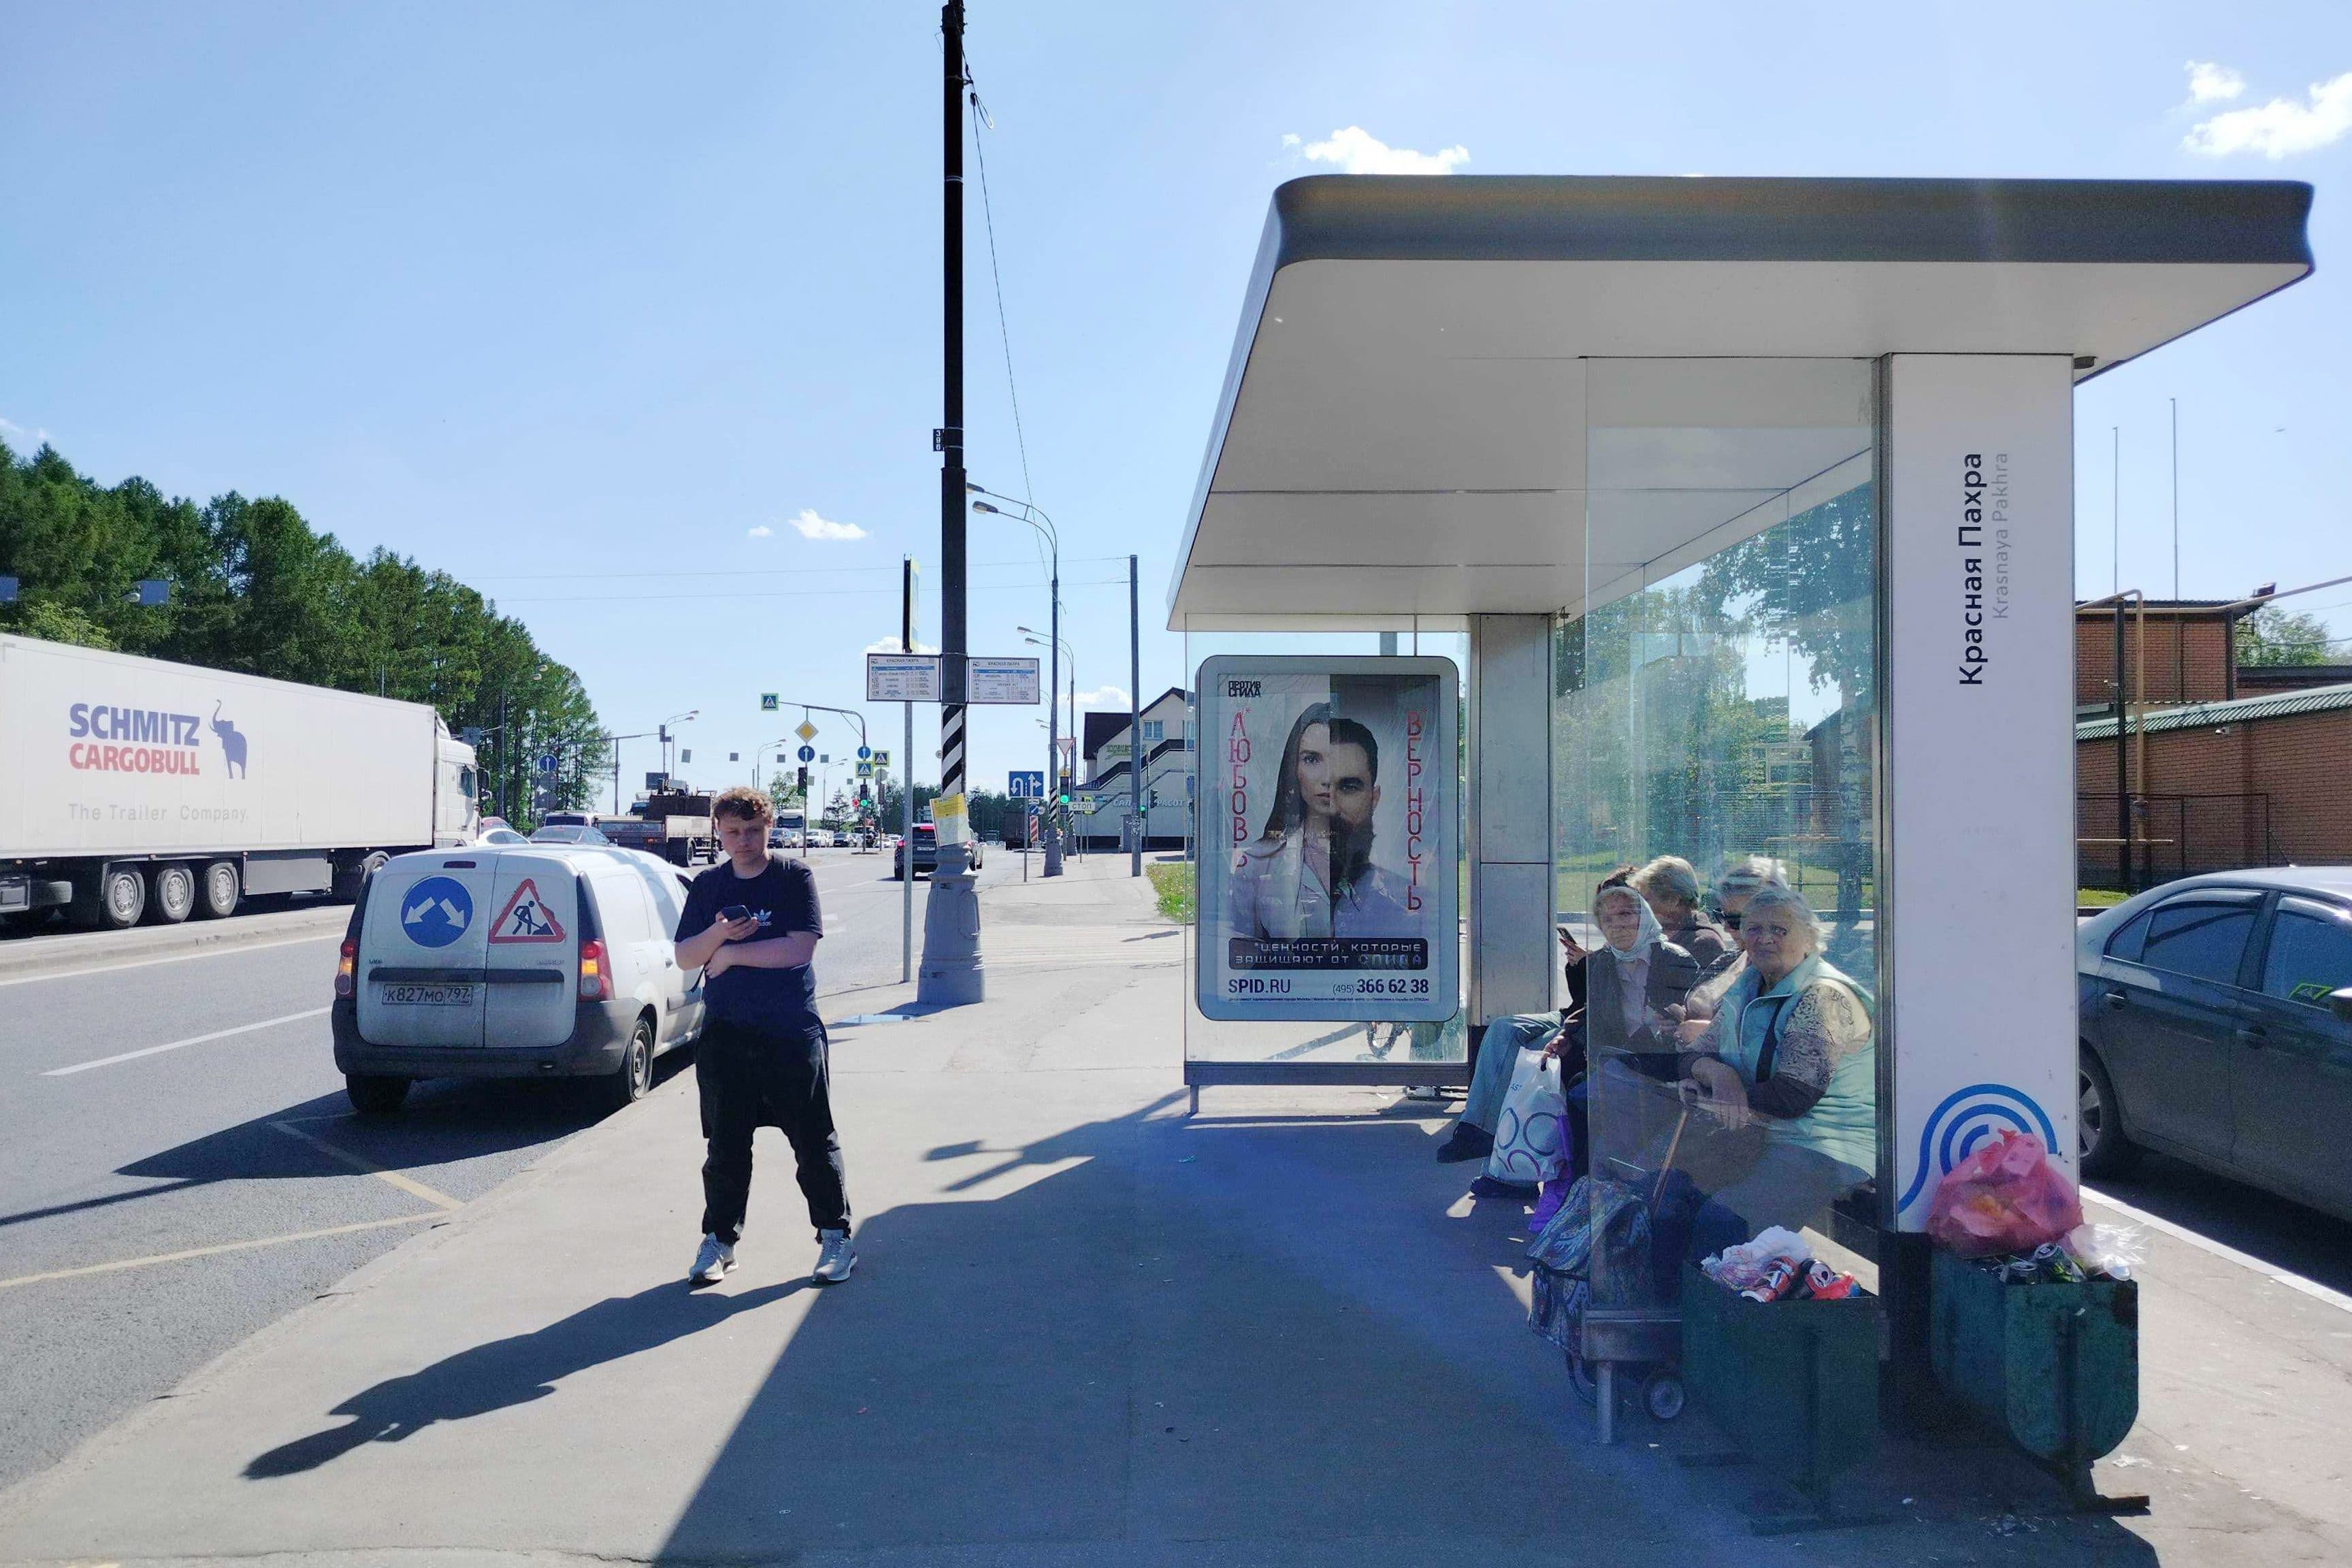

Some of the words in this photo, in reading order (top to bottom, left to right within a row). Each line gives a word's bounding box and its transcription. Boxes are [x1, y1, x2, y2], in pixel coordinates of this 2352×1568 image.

[1958, 453, 1987, 546] Пахра
[1991, 453, 2008, 521] Pakhra
[1992, 529, 2011, 619] Krasnaya
[1959, 558, 1988, 685] Красная
[69, 703, 200, 746] SCHMITZ
[69, 742, 200, 775] CARGOBULL
[68, 803, 101, 820] The
[109, 804, 167, 821] Trailer
[180, 805, 249, 823] Company.
[1235, 955, 1324, 964] ЗАЩИЩАЮТ
[1331, 956, 1350, 964] ОТ
[1351, 943, 1421, 952] КОТОРЫЕ
[1228, 979, 1291, 993] SPID.RU
[1333, 984, 1354, 995] (495)
[1356, 979, 1385, 994] 366
[1388, 979, 1407, 994] 62
[1410, 979, 1429, 994] 38
